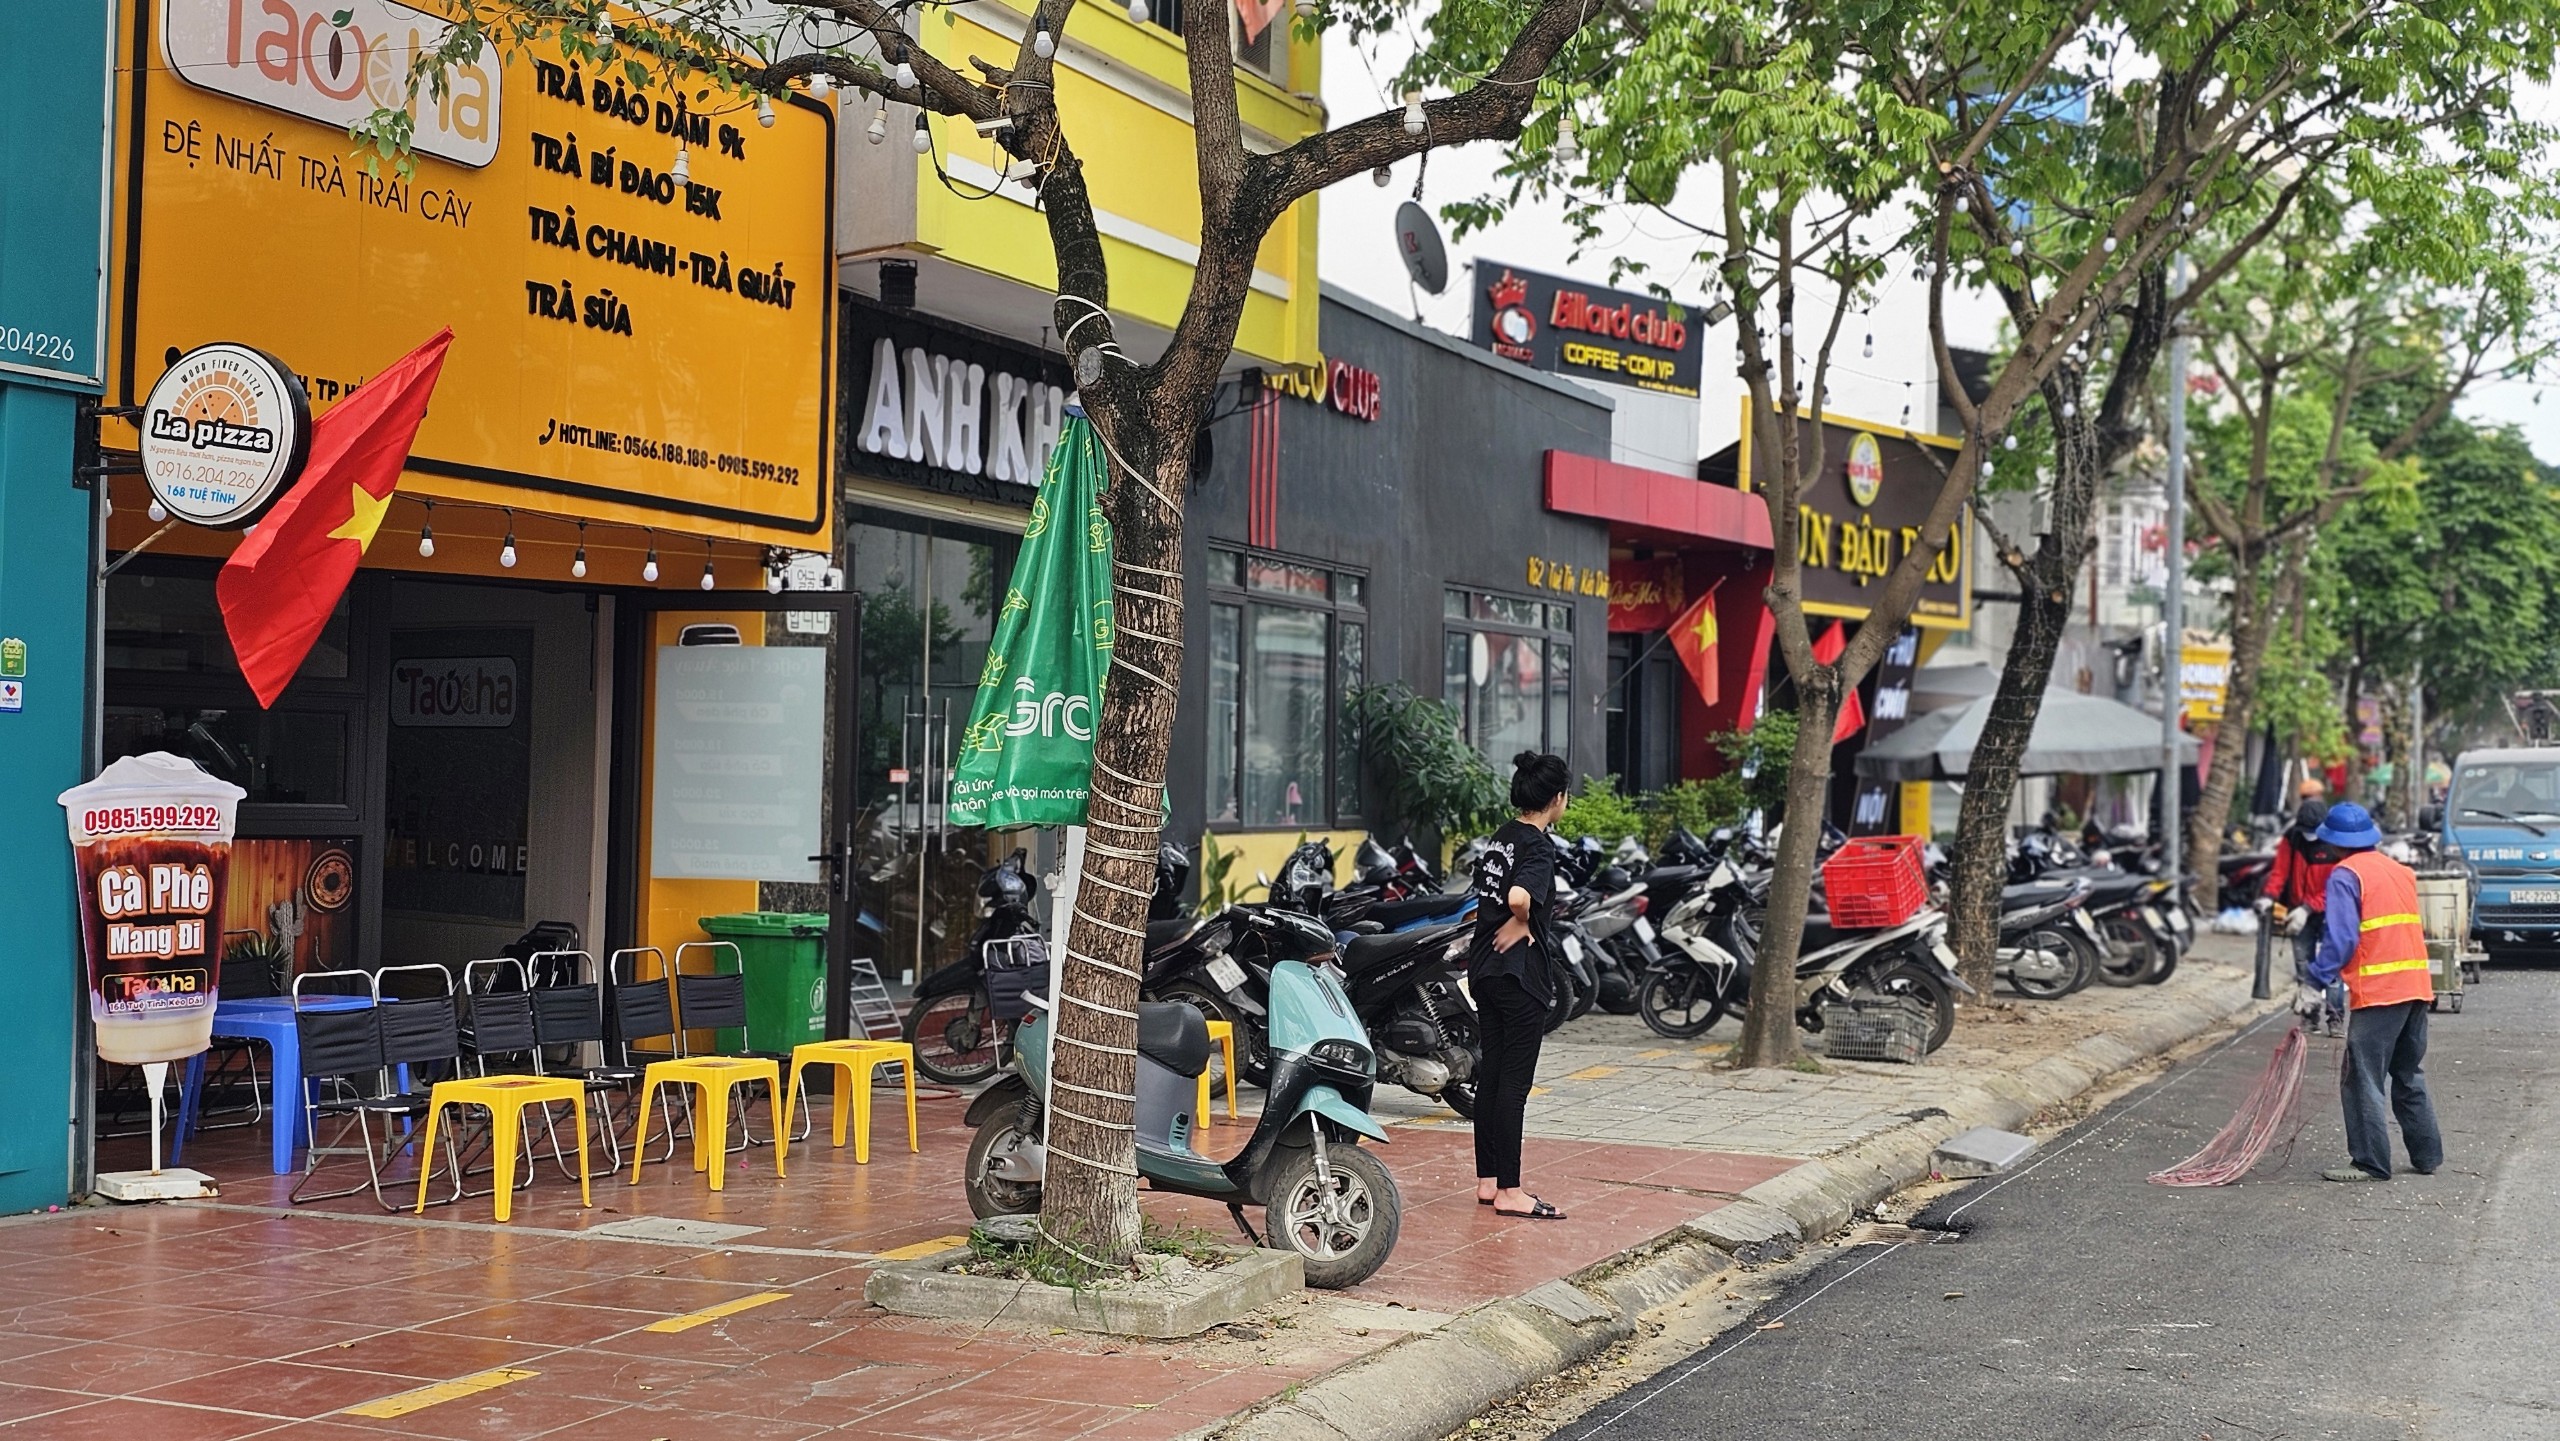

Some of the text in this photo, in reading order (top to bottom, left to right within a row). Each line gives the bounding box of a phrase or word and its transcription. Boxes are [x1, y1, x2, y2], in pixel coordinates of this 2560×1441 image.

[535, 59, 585, 107] TRÀ
[592, 75, 649, 126] ĐÀO
[163, 119, 202, 168] ĐỆ
[215, 131, 286, 181] NHẤT
[298, 154, 347, 198] TRÀ
[420, 188, 472, 229] CÂY
[531, 131, 722, 220] TRÀ BÍ ĐAO 15K
[528, 204, 580, 251] TRÀ
[738, 261, 797, 310] QUẤT
[526, 278, 633, 337] TRÀ SỮA
[1550, 288, 1687, 351] Billard club
[180, 358, 264, 398] WOOD FIRED PIZZA
[315, 377, 340, 402] TP
[1330, 359, 1381, 422] CLUB
[857, 337, 985, 475] ANH
[153, 412, 271, 450] La pizza
[559, 422, 622, 454] HOTLINE:
[155, 460, 255, 489] 0916.204.226
[167, 485, 236, 505] 168 TUỆ TĨNH
[1840, 512, 1892, 587] ĐẬU
[84, 805, 218, 832] 0985.599.292
[951, 797, 987, 815] nhận
[1005, 784, 1020, 799] và
[1022, 786, 1039, 806] gọi
[1040, 785, 1063, 800] món
[1066, 786, 1089, 800] trên
[100, 865, 209, 915] Cà Phê
[110, 922, 201, 955] Mang Đi
[109, 1002, 125, 1011] 168
